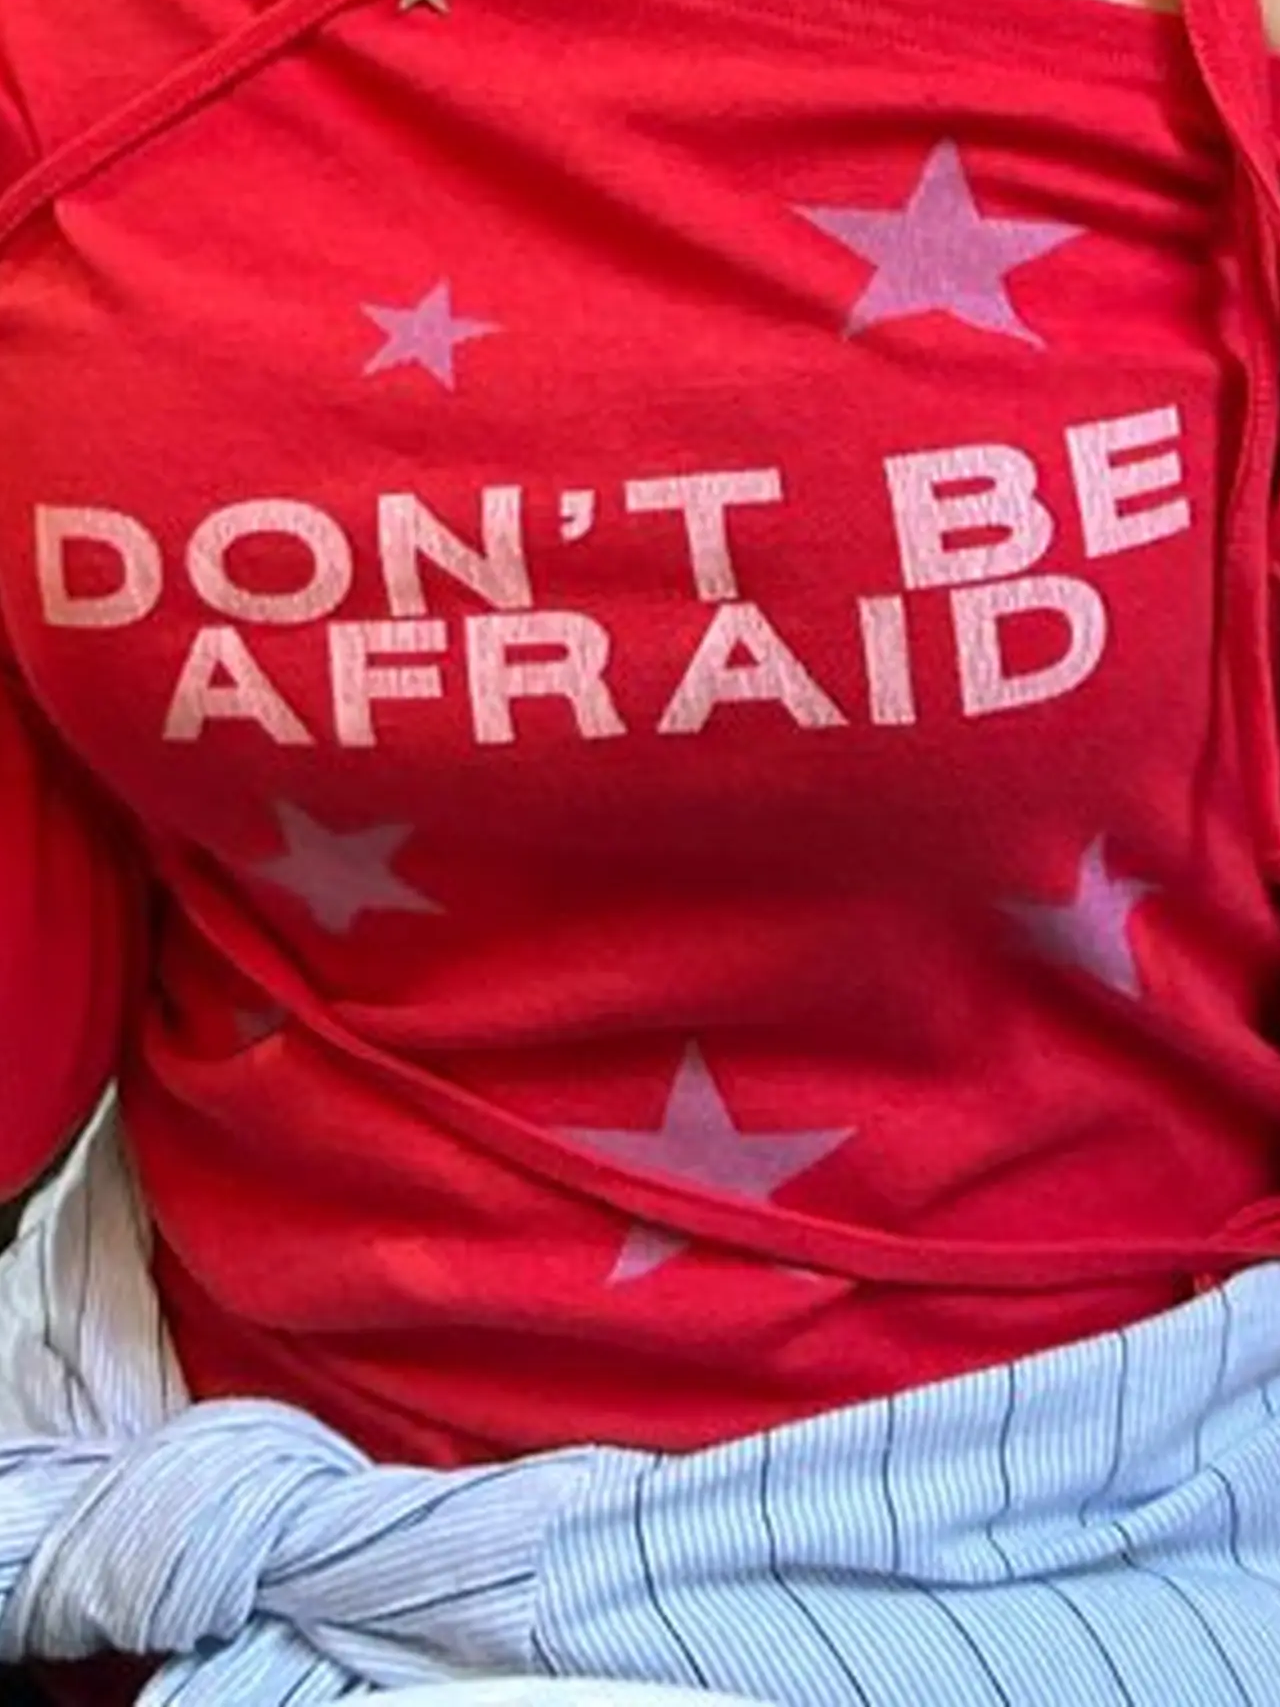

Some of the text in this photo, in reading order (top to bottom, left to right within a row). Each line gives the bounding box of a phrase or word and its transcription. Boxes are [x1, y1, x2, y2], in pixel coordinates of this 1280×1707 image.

[33, 404, 1191, 628] DON'T BE
[163, 575, 1107, 748] AFRAID
